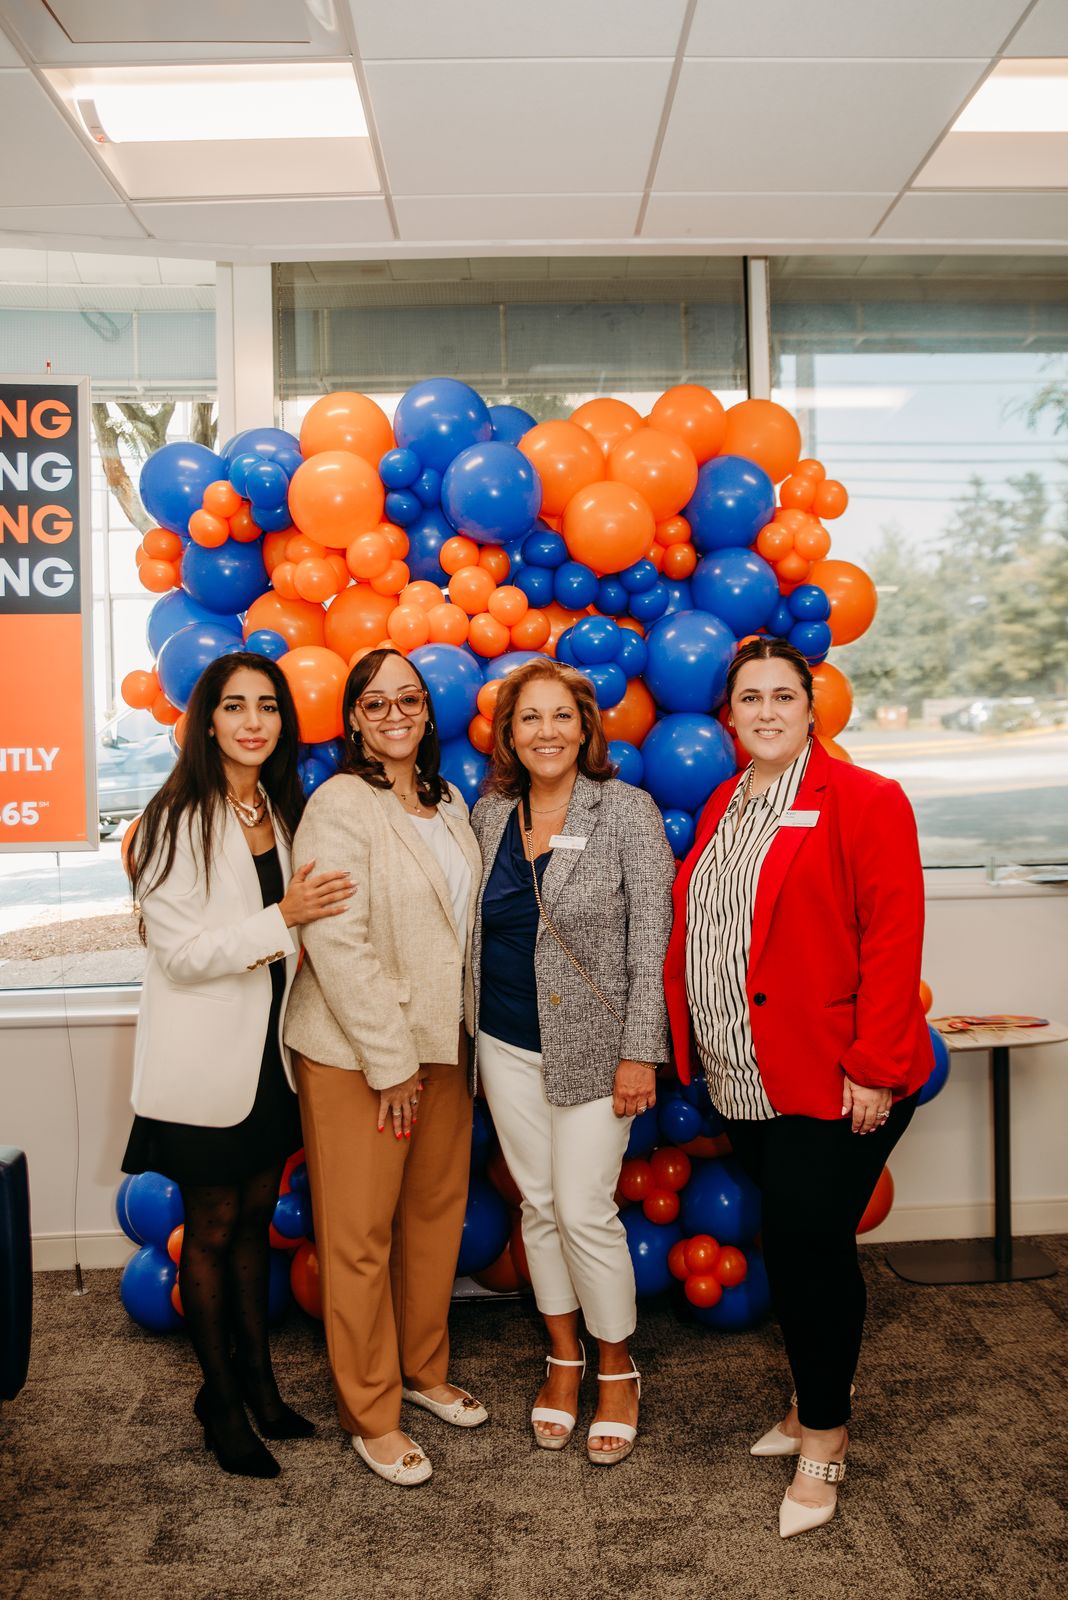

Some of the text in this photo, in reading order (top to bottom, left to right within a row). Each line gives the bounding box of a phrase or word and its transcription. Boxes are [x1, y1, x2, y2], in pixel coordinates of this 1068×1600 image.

[0, 400, 72, 439] NG
[0, 452, 73, 491] NG
[0, 504, 74, 544] NG
[0, 557, 75, 597] NG
